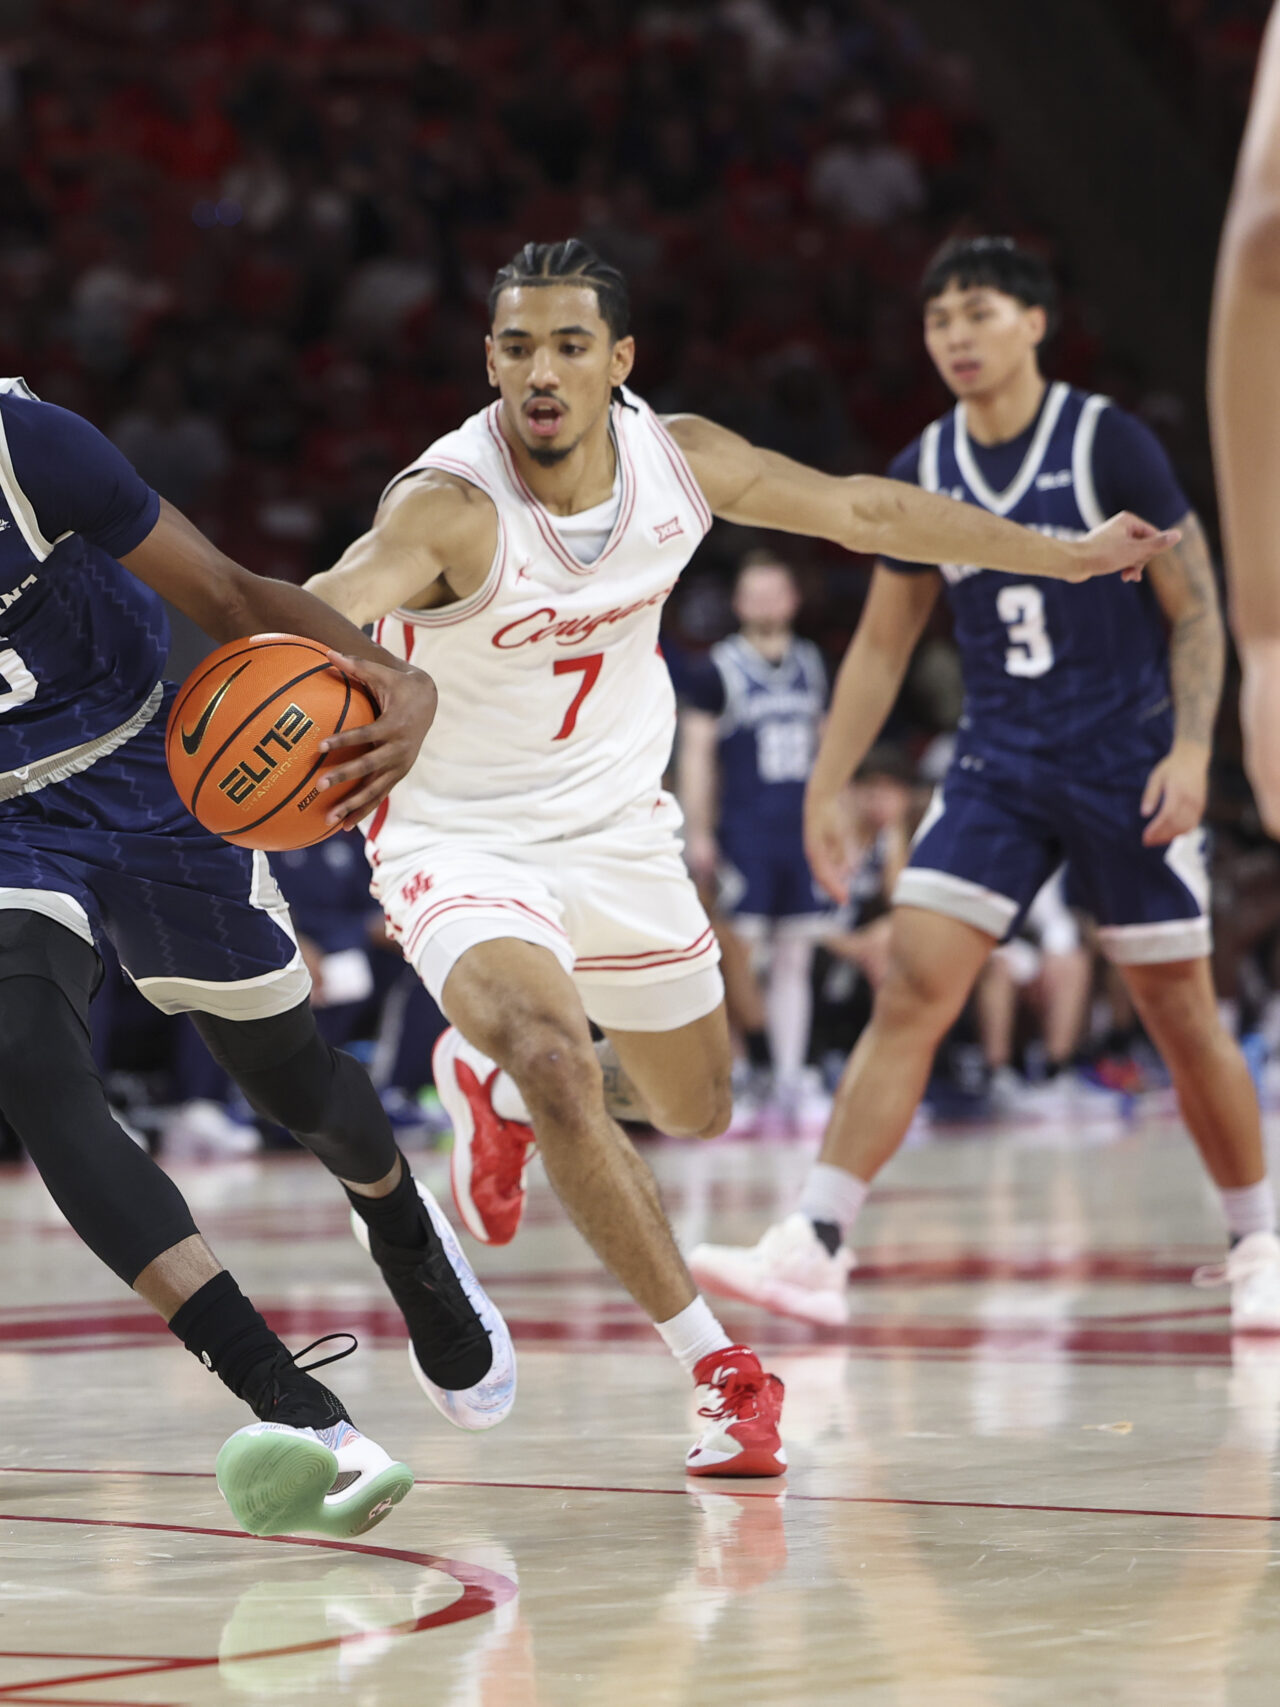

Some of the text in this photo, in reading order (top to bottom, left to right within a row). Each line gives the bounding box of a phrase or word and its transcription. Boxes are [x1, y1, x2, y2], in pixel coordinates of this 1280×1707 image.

[996, 584, 1055, 678] 3
[551, 652, 604, 741] 7
[218, 702, 314, 805] ELITE
